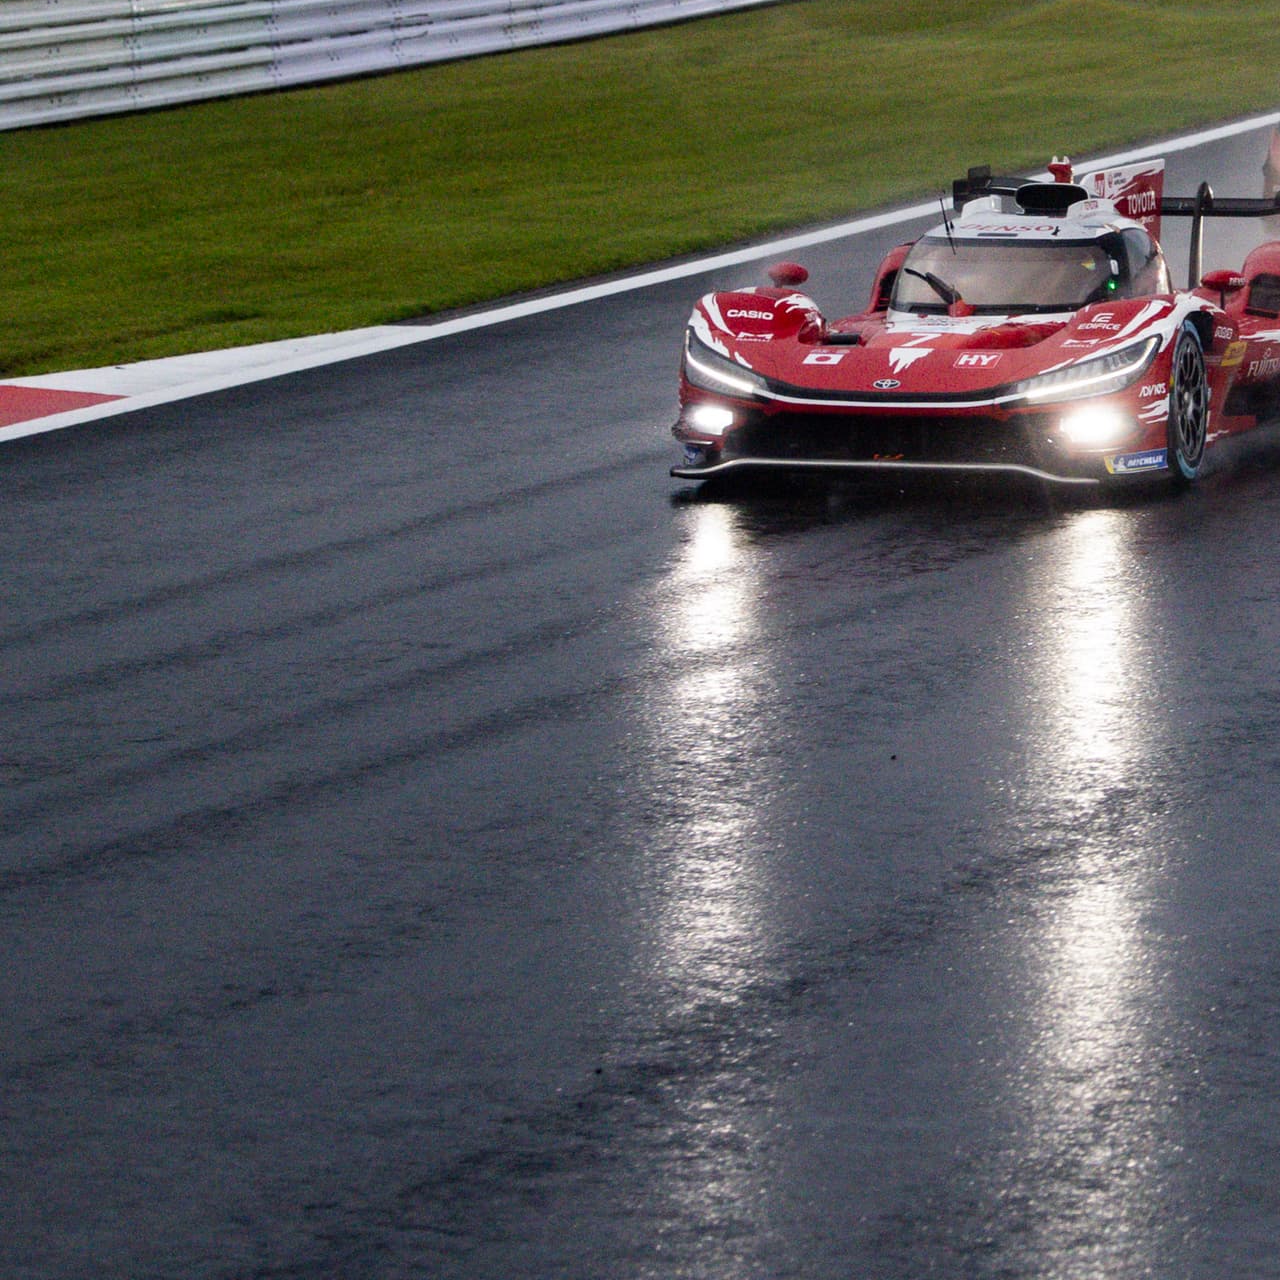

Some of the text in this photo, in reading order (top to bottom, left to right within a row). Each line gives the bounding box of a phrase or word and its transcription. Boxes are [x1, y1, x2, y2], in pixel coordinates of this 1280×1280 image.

[1127, 190, 1157, 216] TOYOTA
[727, 309, 774, 321] CASIO
[1077, 323, 1121, 331] EDIFICE
[959, 354, 998, 366] HY
[1127, 455, 1163, 467] MICHELIN
